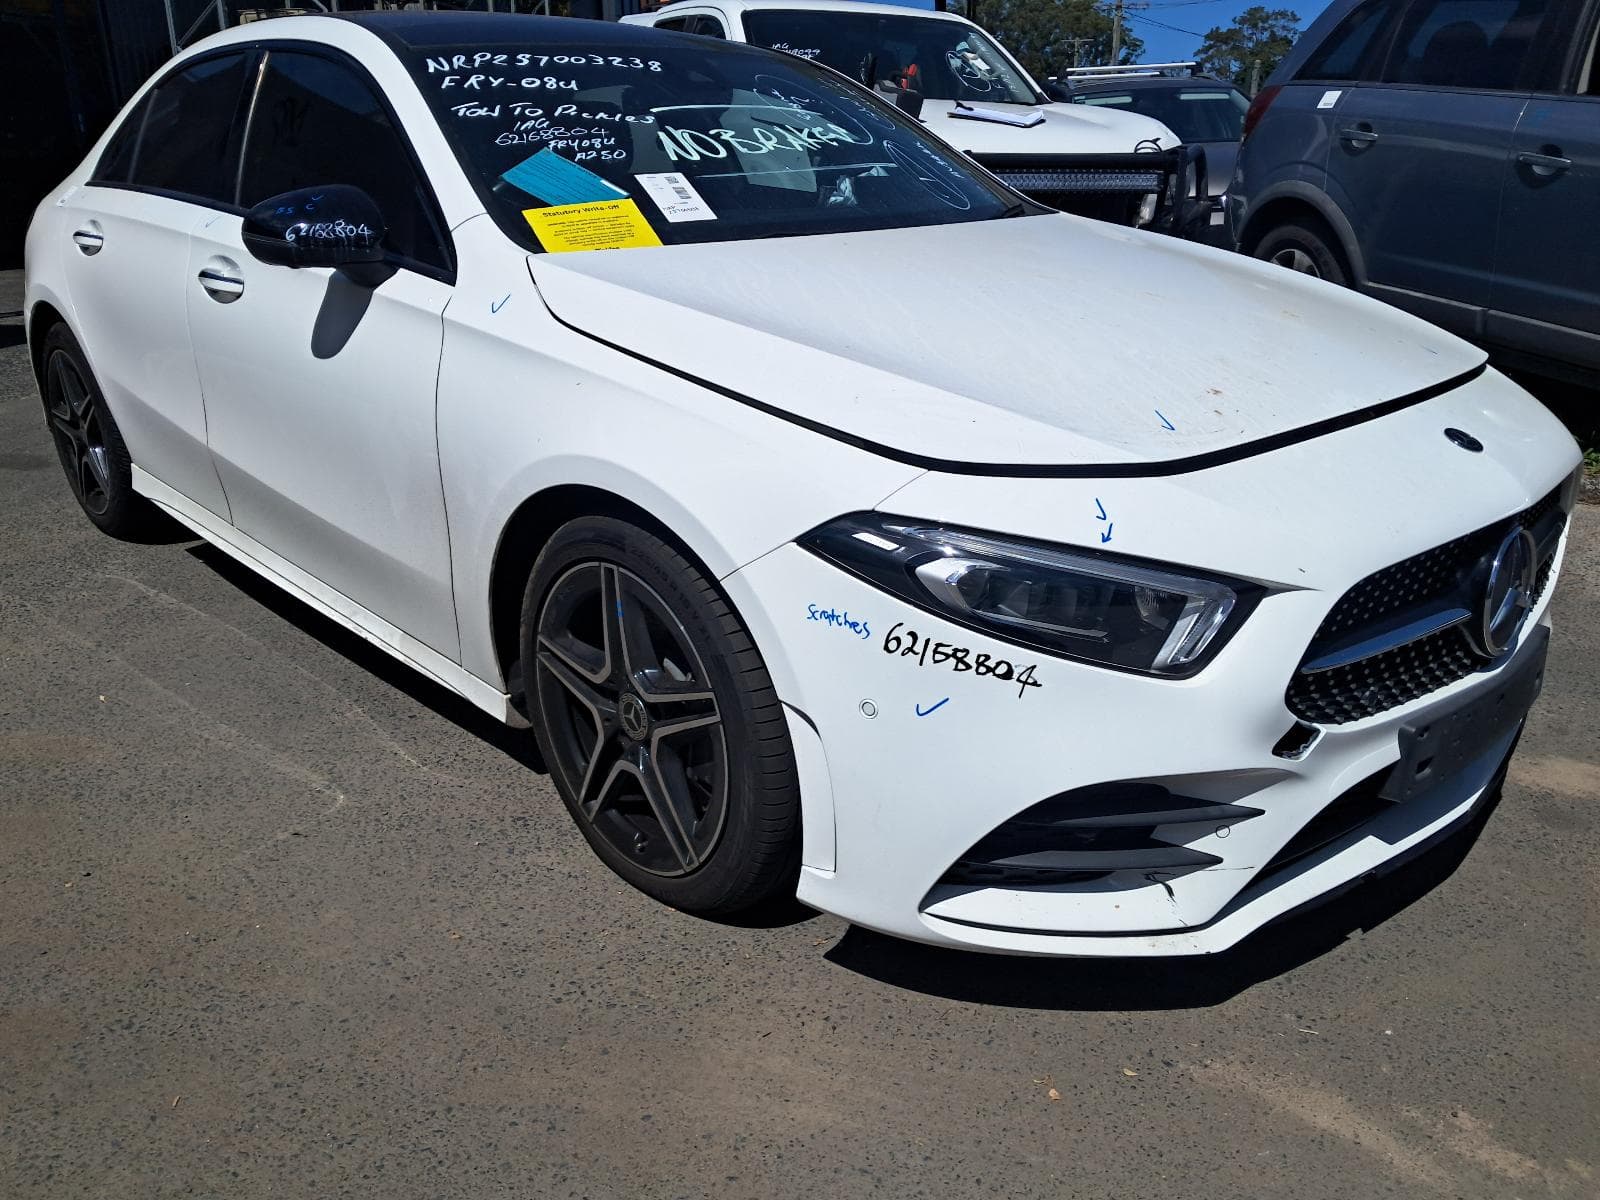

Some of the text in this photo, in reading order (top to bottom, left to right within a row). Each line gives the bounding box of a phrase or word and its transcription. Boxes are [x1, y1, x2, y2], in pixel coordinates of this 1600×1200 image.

[657, 126, 727, 160] NO
[575, 149, 627, 161] A250
[542, 207, 581, 218] Statutory
